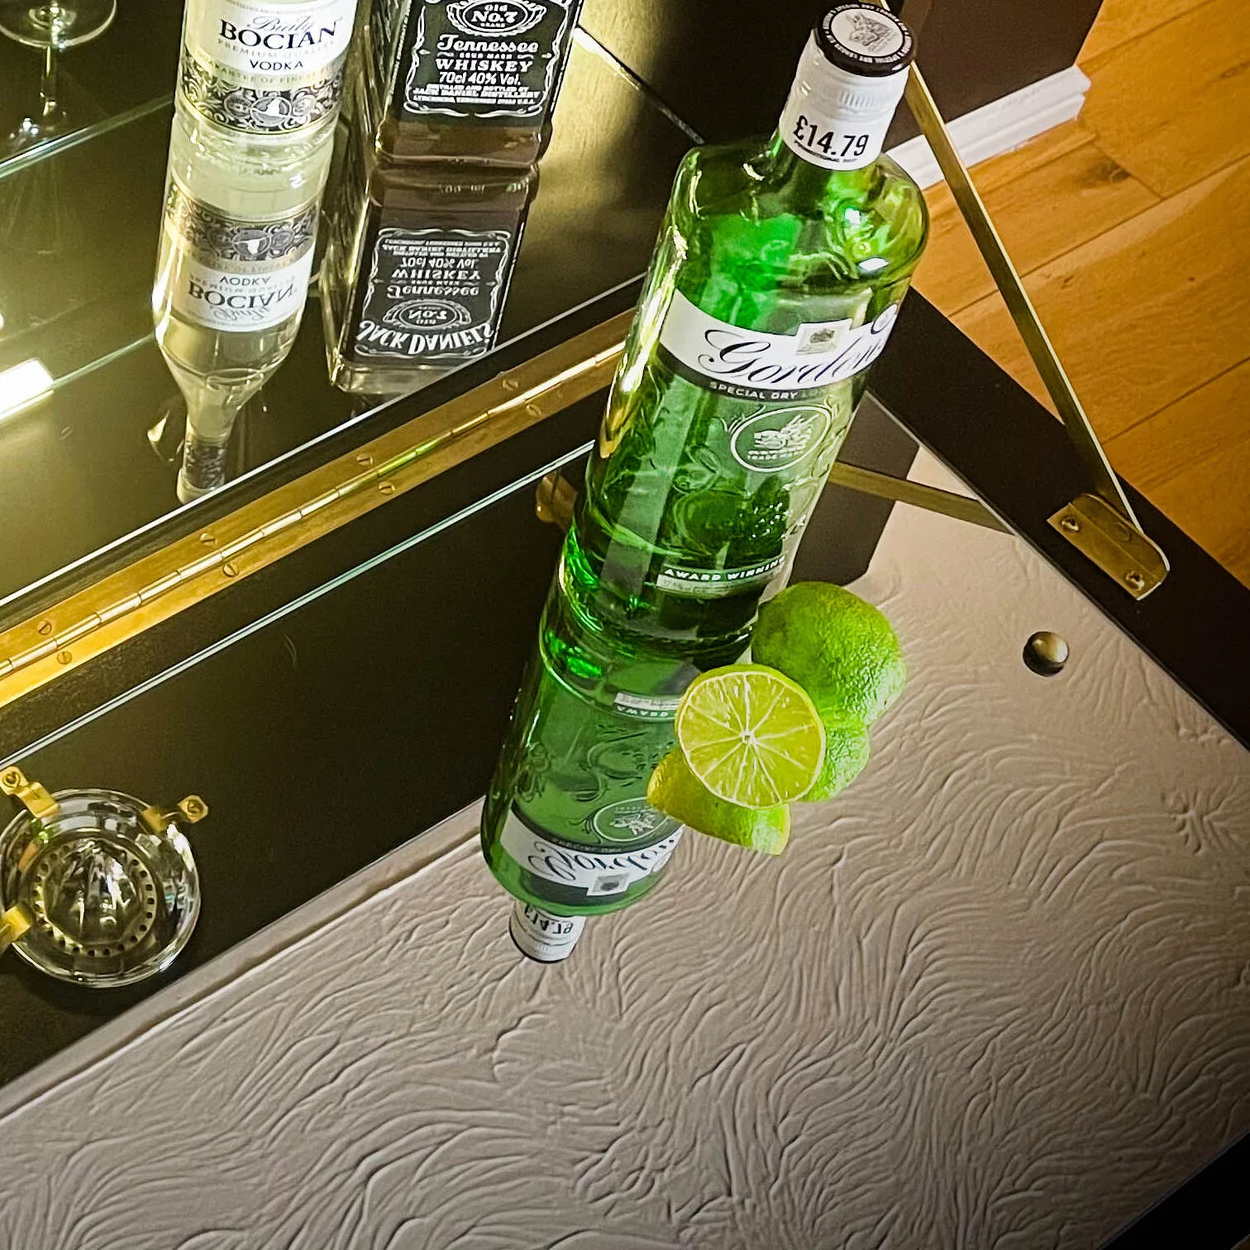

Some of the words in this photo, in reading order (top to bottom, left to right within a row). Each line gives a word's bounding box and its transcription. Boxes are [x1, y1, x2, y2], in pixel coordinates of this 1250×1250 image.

[484, 3, 508, 12] Old
[471, 10, 518, 24] No.7
[218, 18, 337, 50] BOCIAN
[436, 33, 539, 53] Tennessee
[248, 58, 304, 72] VODKA
[435, 58, 534, 73] WHISKEY
[438, 71, 467, 84] 70cl
[467, 72, 497, 84] 40%
[499, 72, 522, 86] Vol.
[793, 114, 870, 157] £14.79
[709, 380, 766, 400] SPECIAL
[770, 390, 799, 400] DRY
[664, 568, 723, 581] AWARD
[726, 554, 786, 581] WINNING
